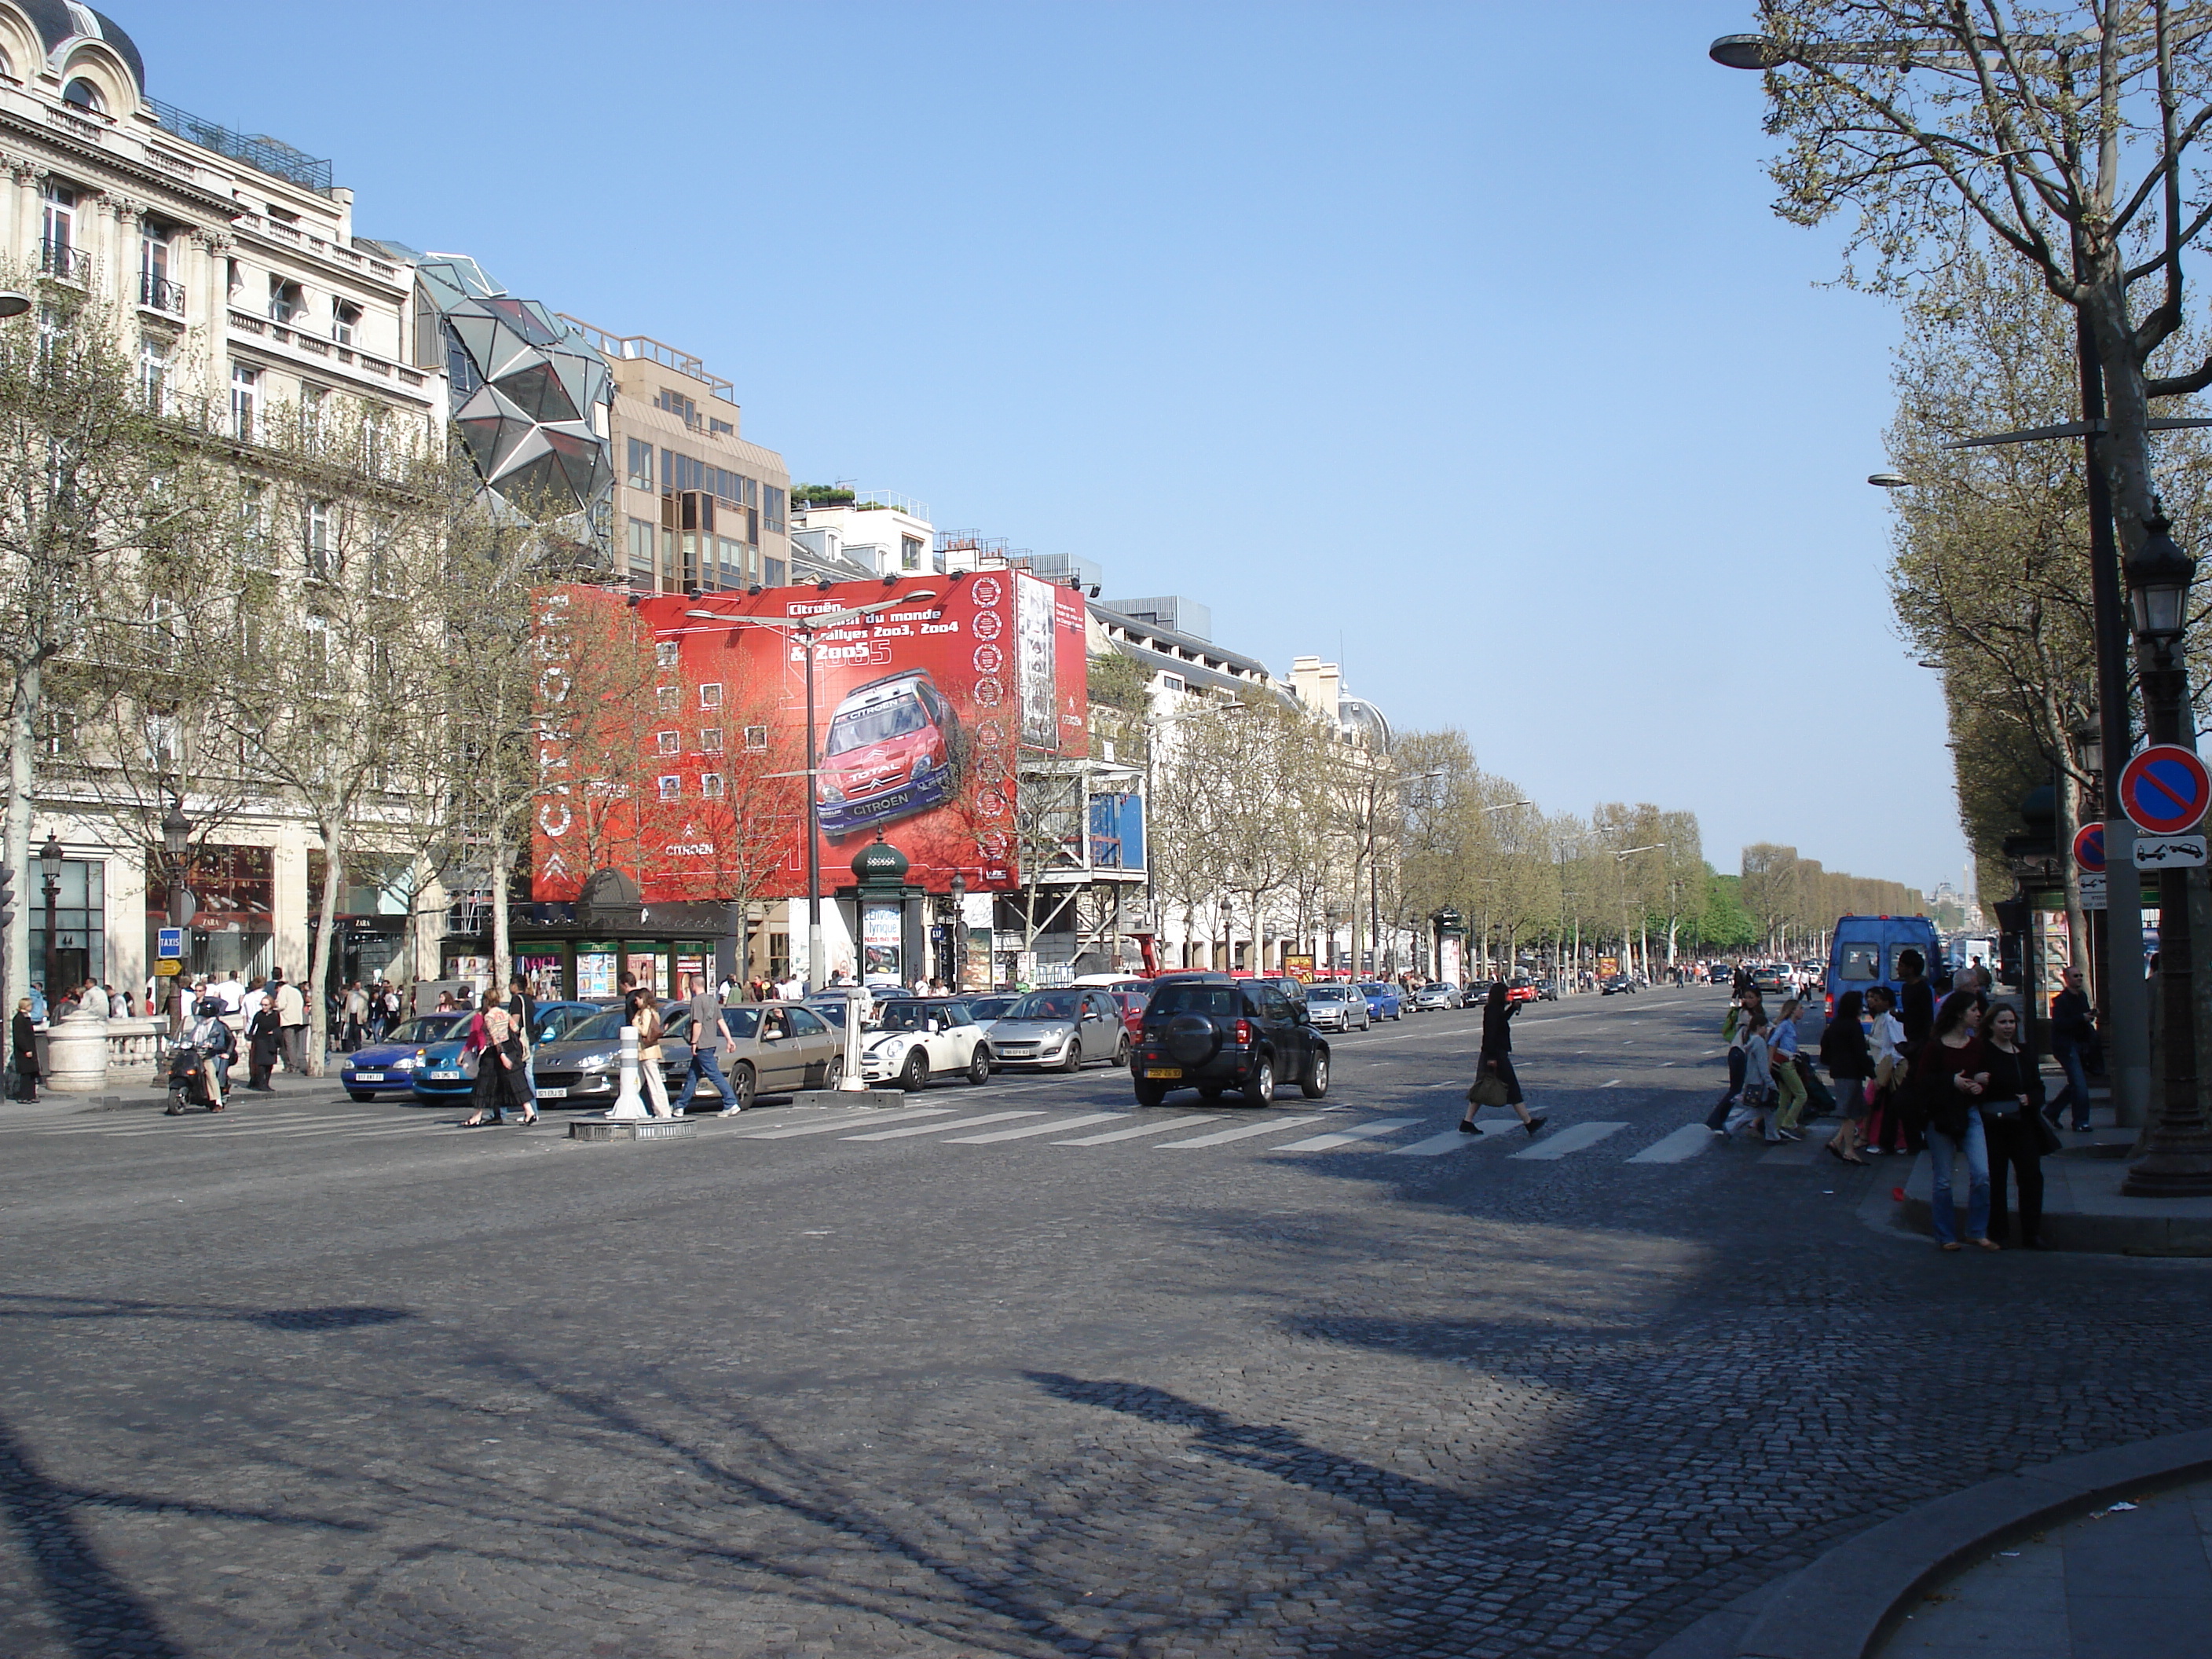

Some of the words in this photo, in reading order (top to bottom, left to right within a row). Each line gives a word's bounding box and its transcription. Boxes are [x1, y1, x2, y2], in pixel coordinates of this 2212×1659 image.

[866, 612, 884, 624] du
[891, 610, 942, 622] monde
[873, 624, 914, 638] 2003,
[921, 621, 959, 635] 2004
[790, 647, 807, 661] &
[815, 643, 870, 660] 2005
[850, 699, 899, 720] CITROËN
[849, 763, 901, 782] TOTAL
[853, 793, 909, 815] CITROËN
[665, 843, 713, 855] CITROËN
[870, 921, 897, 936] lyrique
[160, 938, 179, 947] TAXIS
